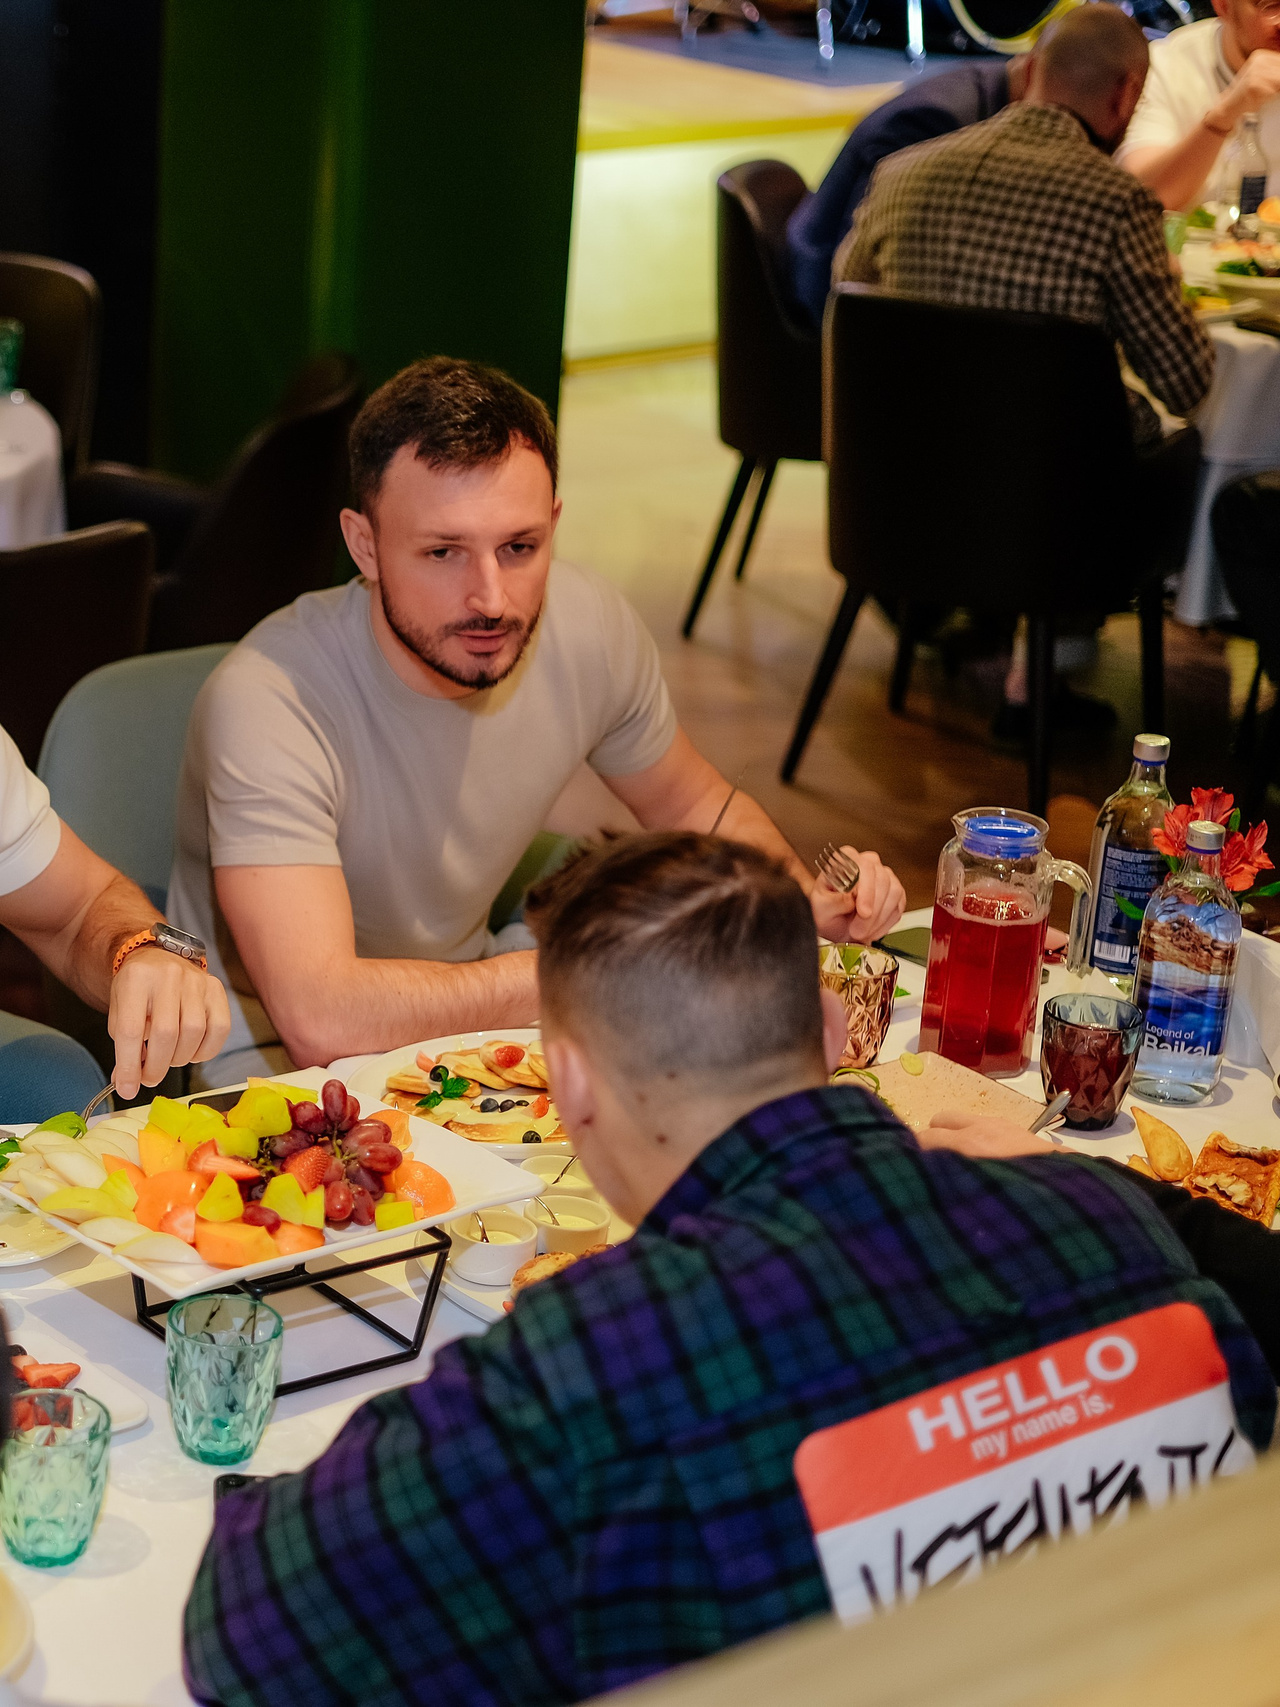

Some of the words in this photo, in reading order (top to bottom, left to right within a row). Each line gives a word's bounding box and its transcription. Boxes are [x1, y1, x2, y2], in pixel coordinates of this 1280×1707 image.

[1146, 1021, 1182, 1038] Legend
[1184, 1030, 1195, 1040] of
[908, 1336, 1138, 1452] HELLO
[971, 1429, 1008, 1460] my
[1012, 1404, 1079, 1444] name
